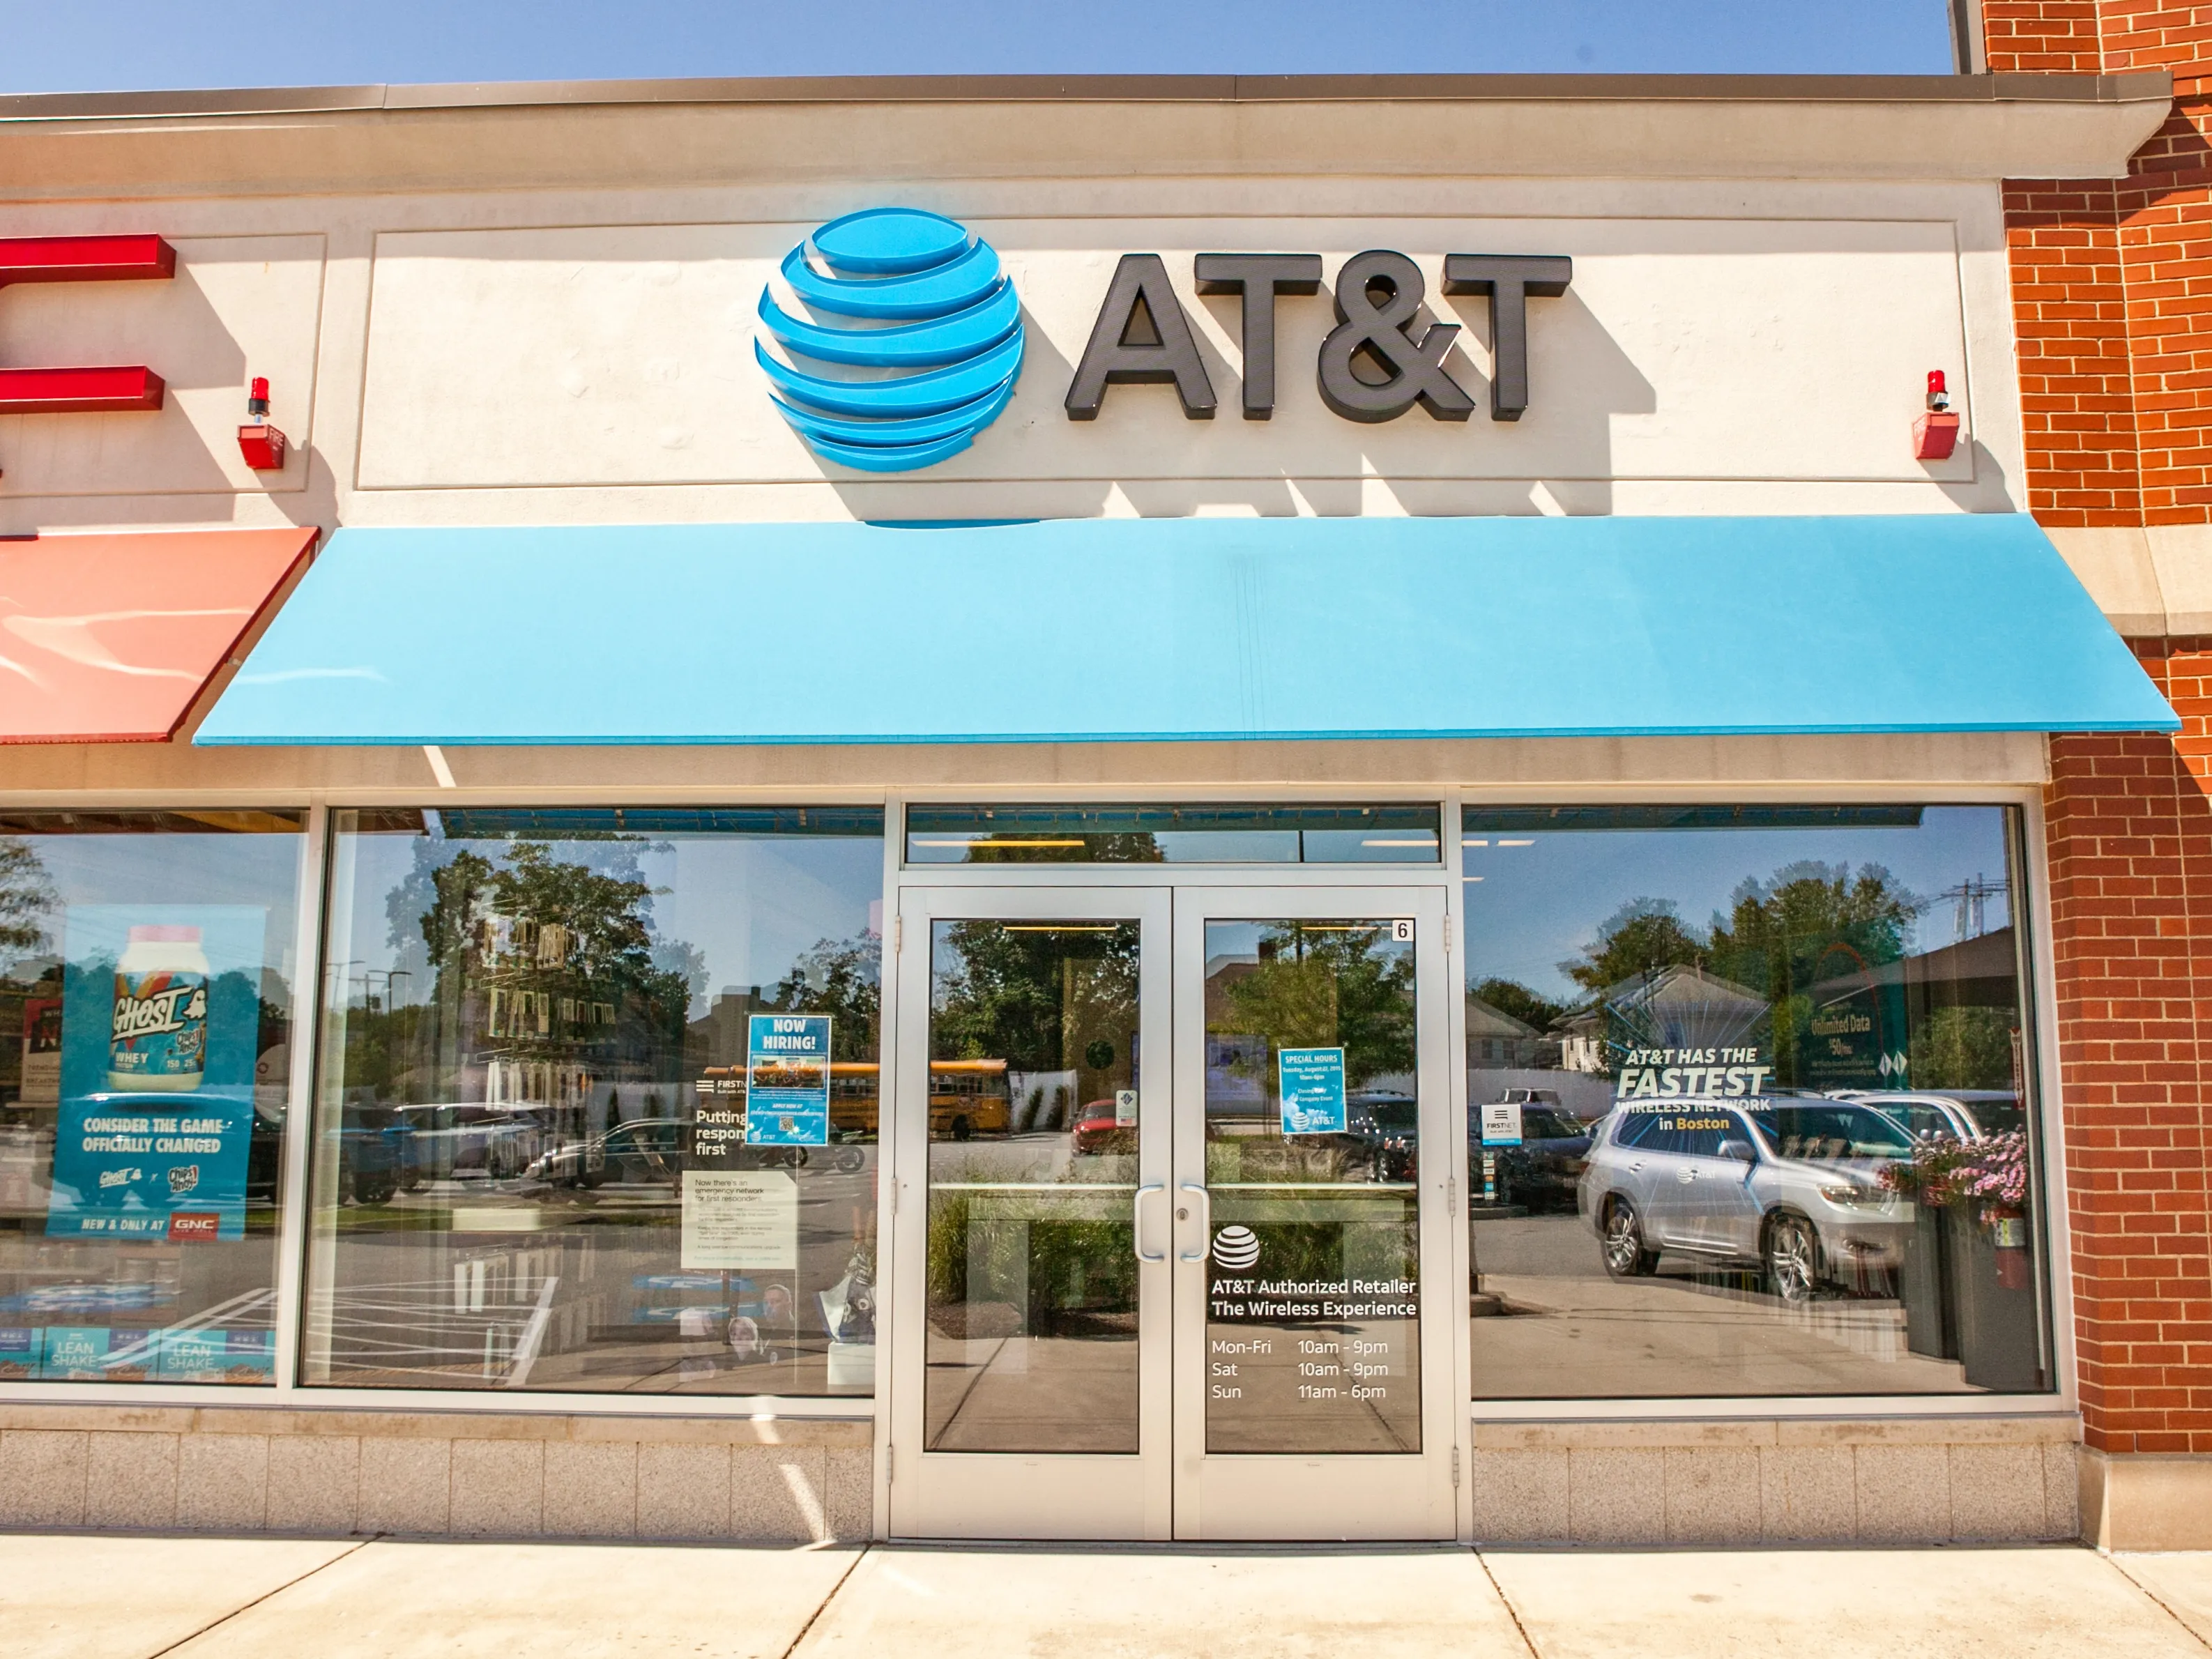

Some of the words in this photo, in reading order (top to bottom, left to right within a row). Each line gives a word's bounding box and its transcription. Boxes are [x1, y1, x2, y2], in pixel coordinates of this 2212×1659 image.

[1064, 248, 1572, 422] AT&T
[270, 428, 284, 446] FIRE
[1398, 922, 1408, 938] 6
[112, 986, 194, 1041] GHOST
[773, 1019, 806, 1033] NOW
[1811, 1014, 1849, 1036] Unlimited
[1850, 1014, 1870, 1032] Data
[763, 1036, 816, 1050] HIRING!
[116, 1052, 148, 1064] WHEY
[1285, 1055, 1312, 1064] SPECIAL
[1315, 1055, 1337, 1063] HOURS
[1625, 1049, 1675, 1065] AT&T
[1677, 1048, 1716, 1064] HAS
[1721, 1048, 1757, 1063] THE
[717, 1080, 747, 1088] FIRSTN
[1617, 1066, 1771, 1099] FASTEST
[1616, 1101, 1691, 1114] WIRELESS
[1694, 1099, 1771, 1113] NETWORK
[83, 1117, 149, 1133] CONSIDER
[153, 1117, 178, 1133] THE
[181, 1118, 223, 1133] GAME
[696, 1110, 747, 1126] Putting
[1312, 1117, 1335, 1125] AT&T
[1658, 1117, 1673, 1130] in
[1677, 1117, 1730, 1130] Boston
[696, 1129, 745, 1142] respon
[82, 1137, 153, 1152] OFFICIALLY
[155, 1138, 222, 1153] CHANGED
[696, 1141, 726, 1156] first
[82, 1218, 106, 1230] NEW
[108, 1219, 117, 1230] &
[120, 1220, 147, 1230] ONLY
[150, 1220, 165, 1231] AT
[175, 1219, 215, 1230] GNC
[1212, 1279, 1254, 1294] AT&T
[1258, 1279, 1348, 1294] Authorized
[1352, 1279, 1416, 1294] Retailer
[1212, 1301, 1244, 1316] The
[1248, 1301, 1319, 1316] Wireless
[1322, 1301, 1417, 1319] Experience
[57, 1342, 94, 1354] LEAN
[173, 1345, 211, 1357] LEAN
[1212, 1340, 1272, 1354] Mon-Fri
[1297, 1340, 1339, 1354] 10am
[1353, 1340, 1388, 1357] 9pm
[51, 1355, 96, 1367] SHAKE
[167, 1358, 215, 1370] SHAKE
[1212, 1363, 1238, 1376] Sat
[1297, 1363, 1339, 1376] 10am
[1353, 1363, 1388, 1379] 9pm
[1212, 1385, 1242, 1398] Sun
[1298, 1385, 1336, 1398] 11am
[1351, 1385, 1386, 1402] 6pm
